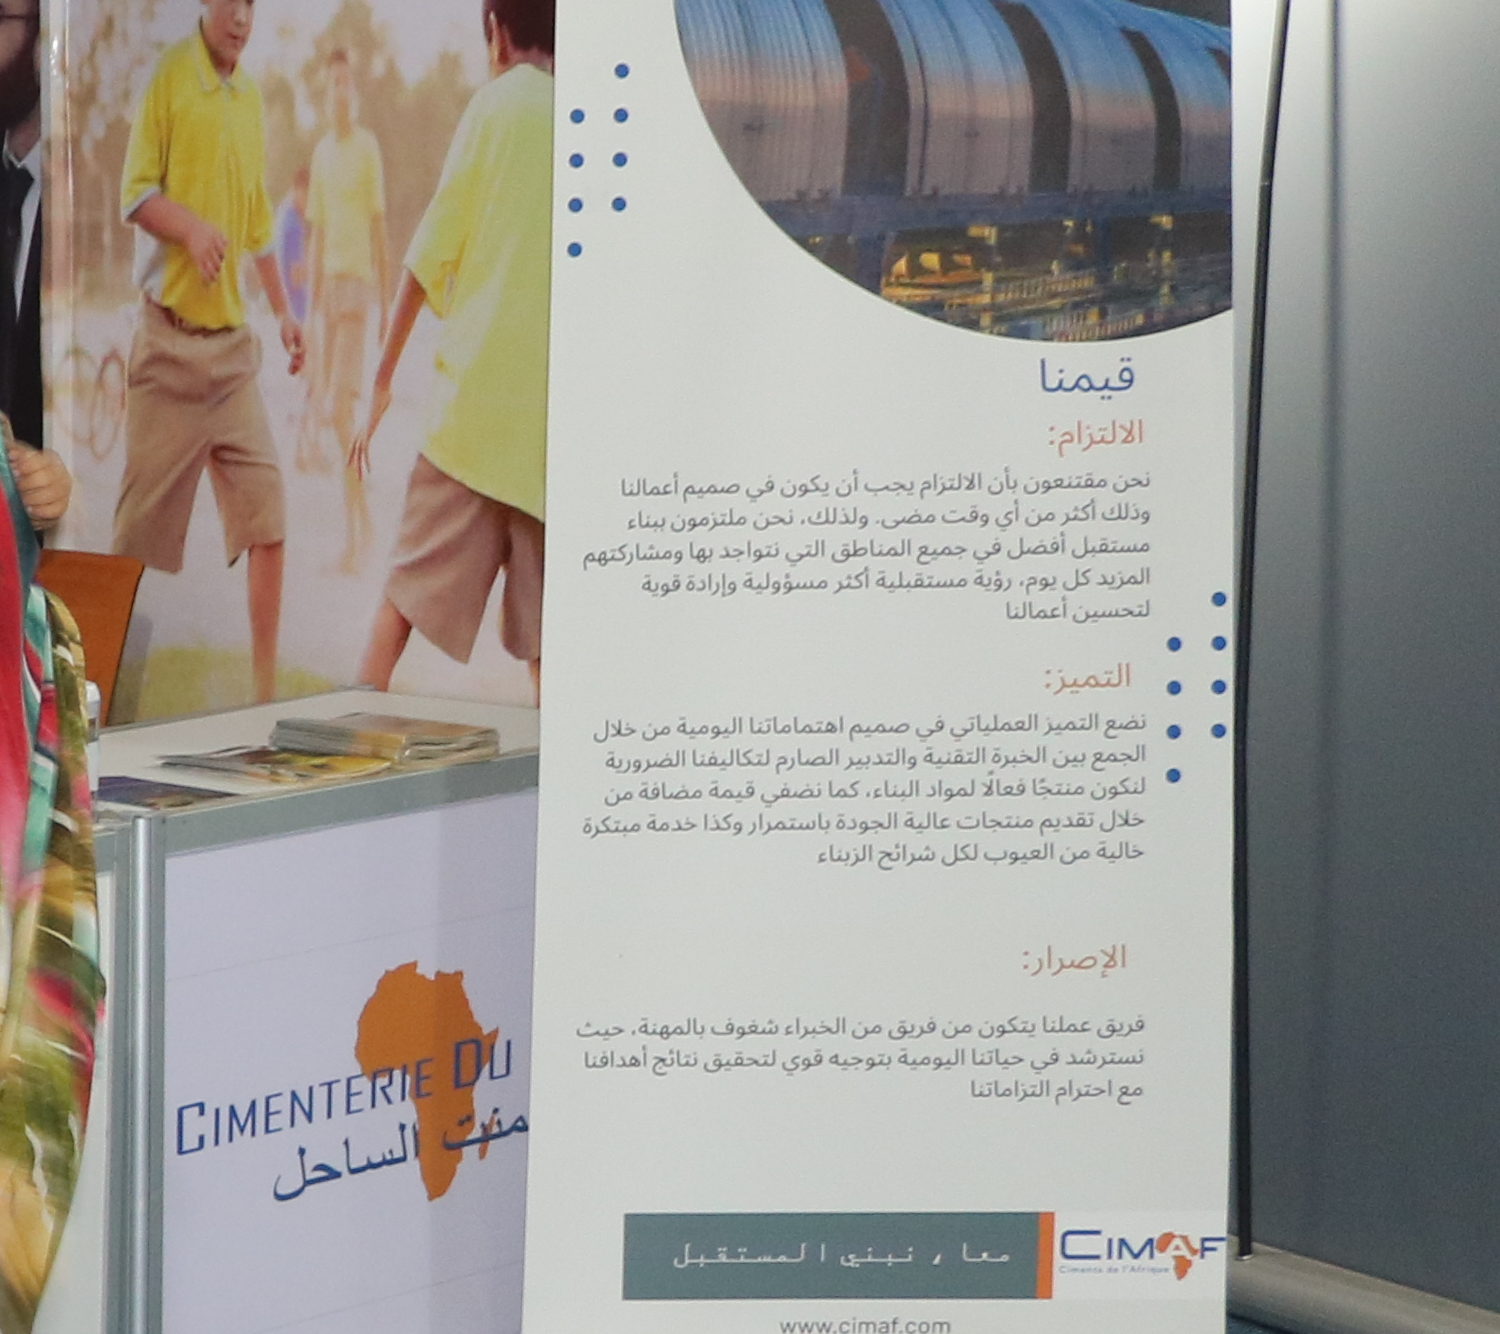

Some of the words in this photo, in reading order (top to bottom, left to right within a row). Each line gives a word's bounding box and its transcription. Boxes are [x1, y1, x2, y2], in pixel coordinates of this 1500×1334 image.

[1039, 357, 1135, 401] قيمنا
[1049, 419, 1145, 457] الالتزام:
[620, 471, 679, 497] أعمالنا
[682, 480, 741, 503] صميم
[745, 474, 775, 502] في
[780, 473, 830, 498] يكون
[834, 468, 859, 498] أن
[864, 476, 914, 497] يجب
[920, 472, 982, 498] الالتزام
[987, 466, 1018, 496] بأن
[1023, 473, 1107, 495] مقتنعون
[1112, 471, 1151, 493] نحن
[1045, 663, 1131, 697] التميز:
[1023, 943, 1127, 978] الإصرار:
[175, 1056, 436, 1158] CIMENTERIE
[452, 1037, 513, 1091] DU
[442, 1106, 529, 1152] منت
[272, 1120, 419, 1203] الساحل
[1060, 1230, 1227, 1260] CIMAF
